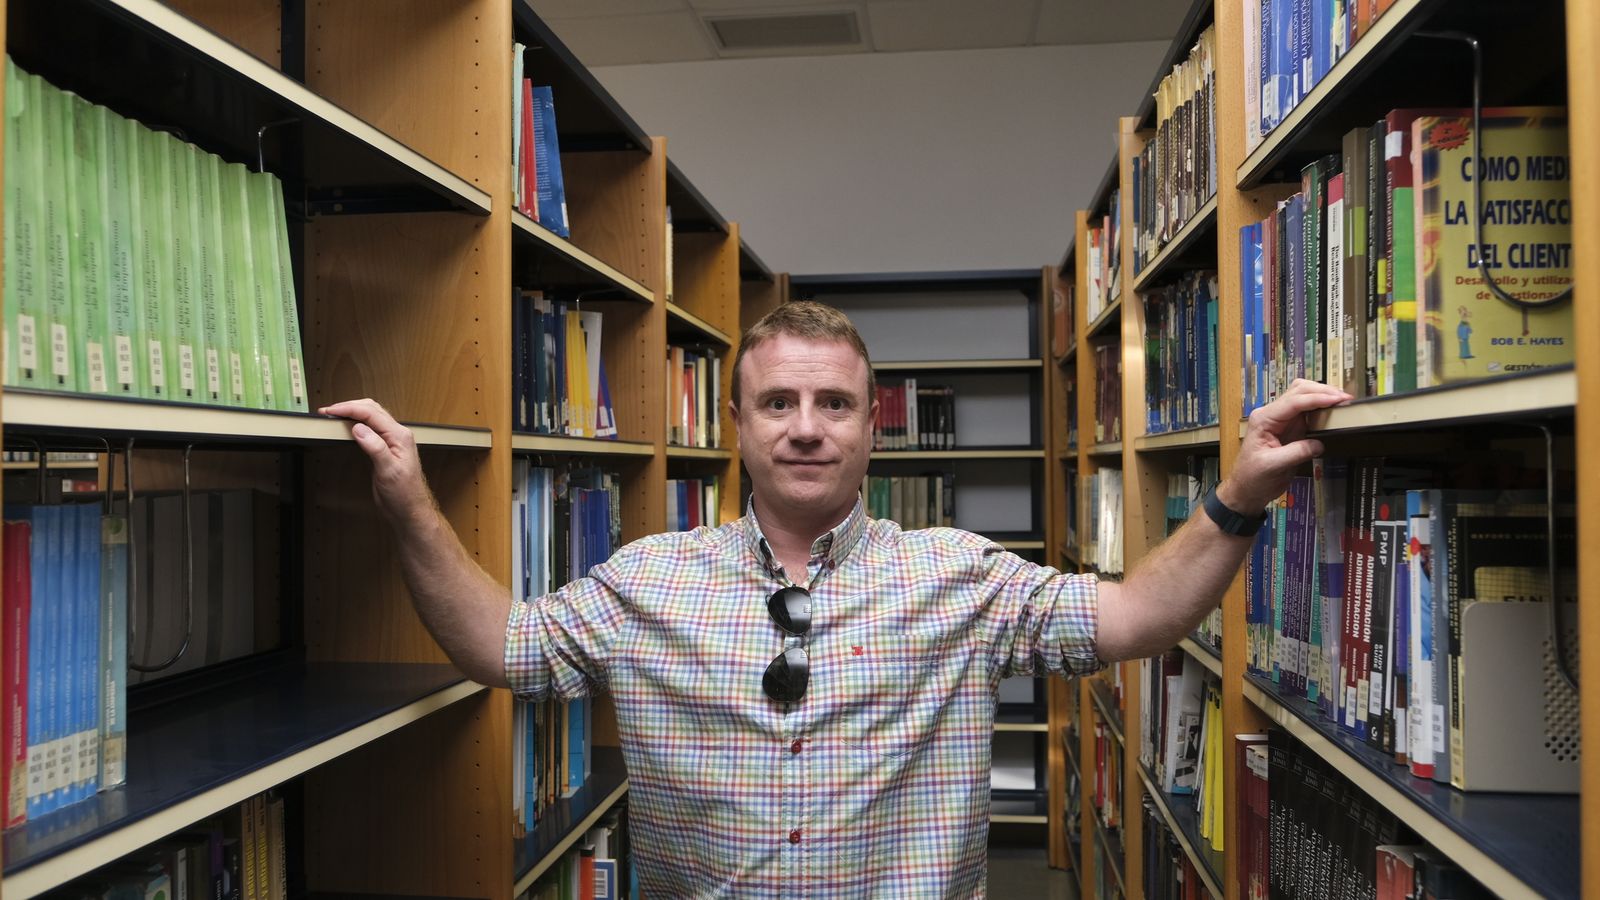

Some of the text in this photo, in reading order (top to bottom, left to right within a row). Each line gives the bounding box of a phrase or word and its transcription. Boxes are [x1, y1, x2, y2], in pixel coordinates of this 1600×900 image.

[1444, 200, 1570, 226] LA ATISFACC
[1467, 244, 1502, 269] DEL
[1307, 275, 1312, 288] of
[1522, 277, 1529, 287] y
[1476, 291, 1490, 300] de
[1491, 338, 1564, 346] BOB E. HAYES
[1380, 532, 1388, 566] PMP
[1363, 555, 1374, 643] ADMINISTRACIÓN
[1431, 640, 1438, 654] of
